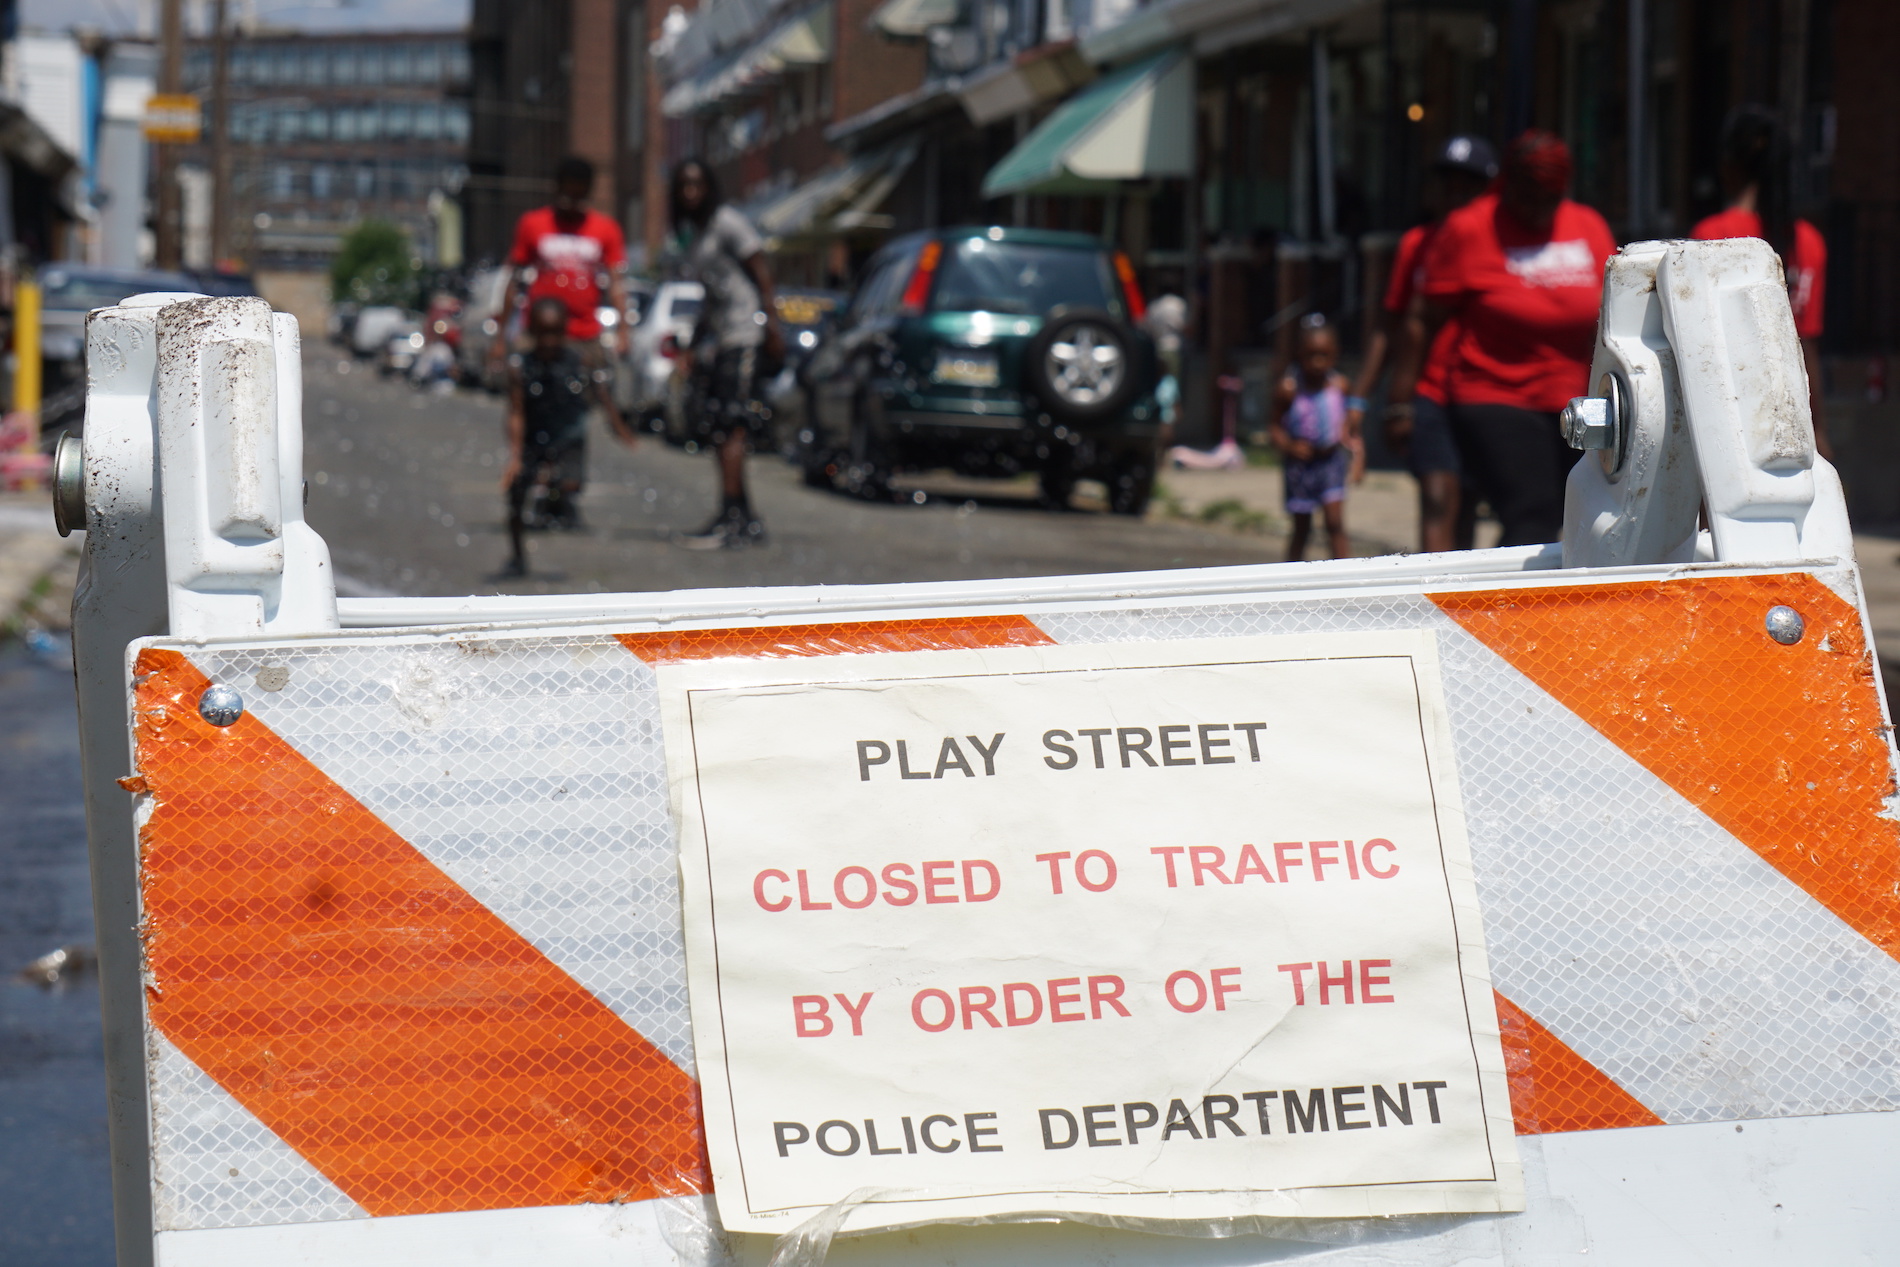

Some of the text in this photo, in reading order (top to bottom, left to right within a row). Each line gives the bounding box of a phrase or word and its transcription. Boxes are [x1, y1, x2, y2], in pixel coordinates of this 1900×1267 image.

[857, 722, 1267, 782] PLAY STREET
[752, 838, 1401, 913] CLOSED TO TRAFFIC
[792, 959, 1396, 1038] BY ORDER OF THE
[773, 1081, 1448, 1158] POLICE DEPARTMENT
